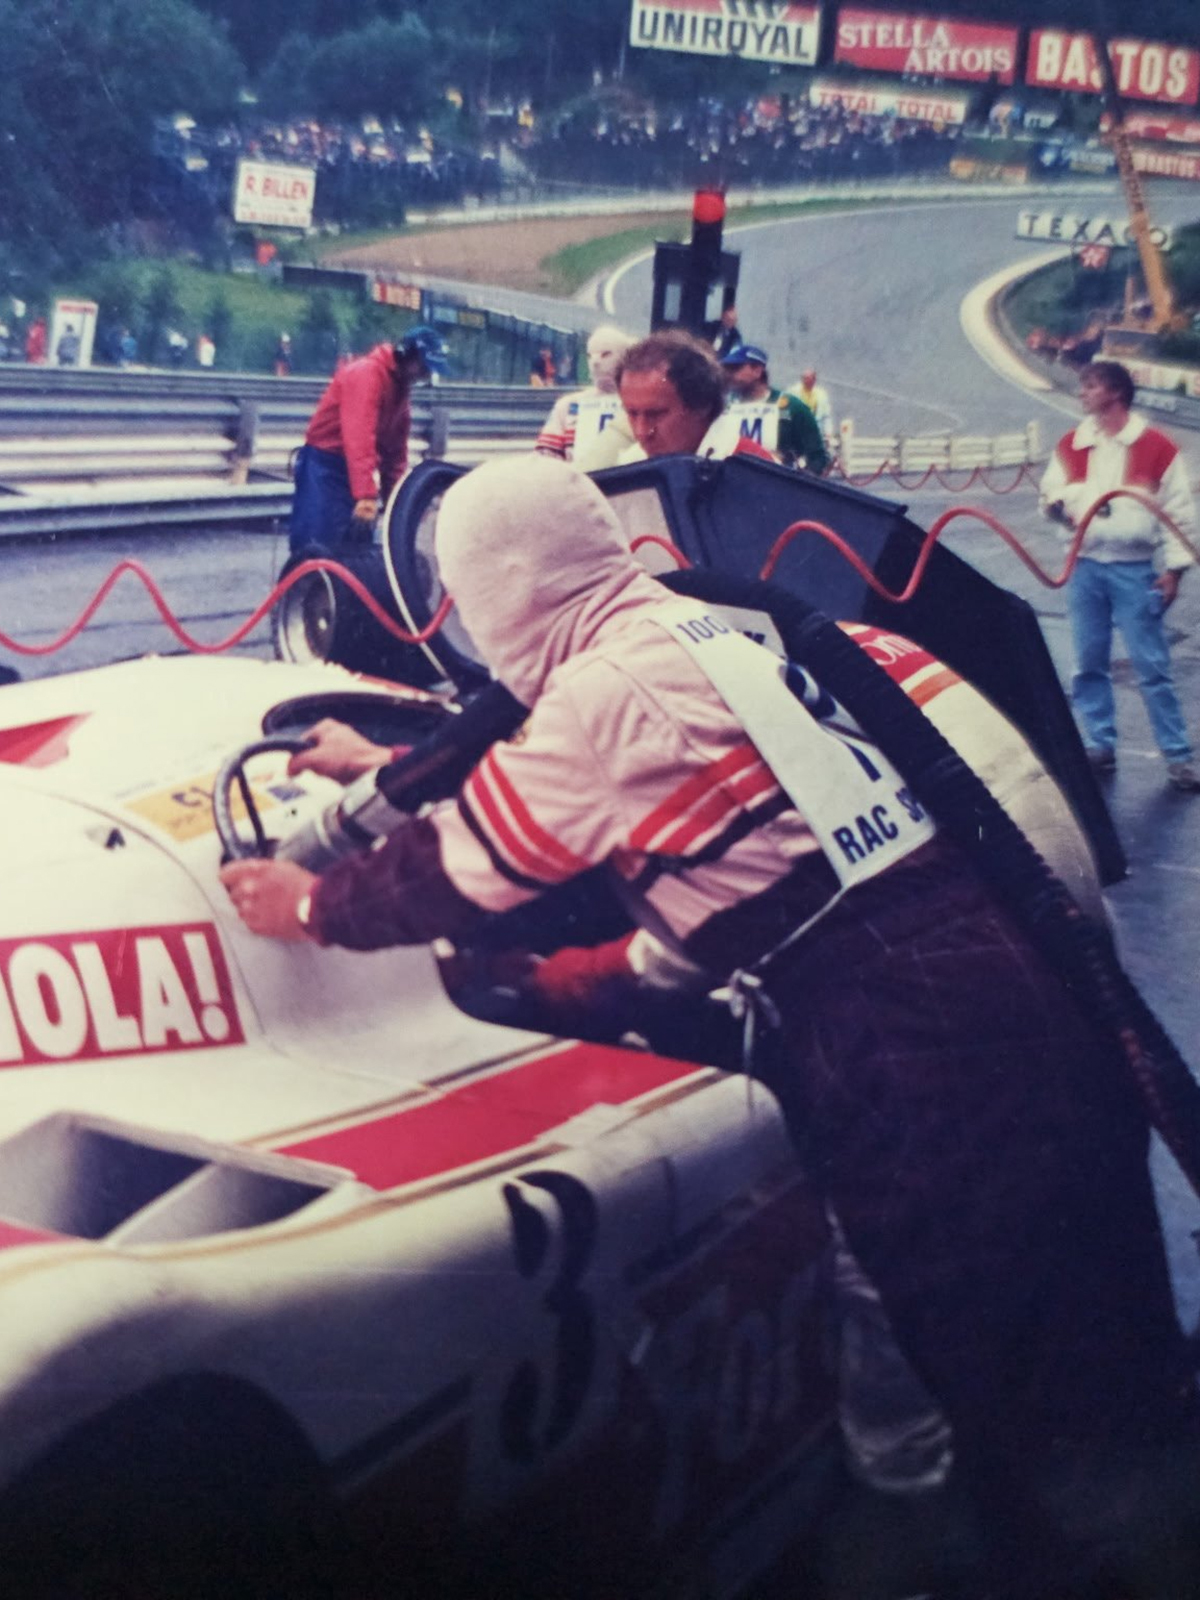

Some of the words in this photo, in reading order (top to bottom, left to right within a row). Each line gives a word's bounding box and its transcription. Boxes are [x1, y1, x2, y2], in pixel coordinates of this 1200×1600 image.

[638, 10, 809, 59] UNIROYAL
[837, 22, 951, 50] STELLA
[903, 47, 1012, 74] ARTOIS
[896, 98, 957, 121] TOTAL
[740, 417, 763, 447] M
[832, 804, 899, 865] RAC
